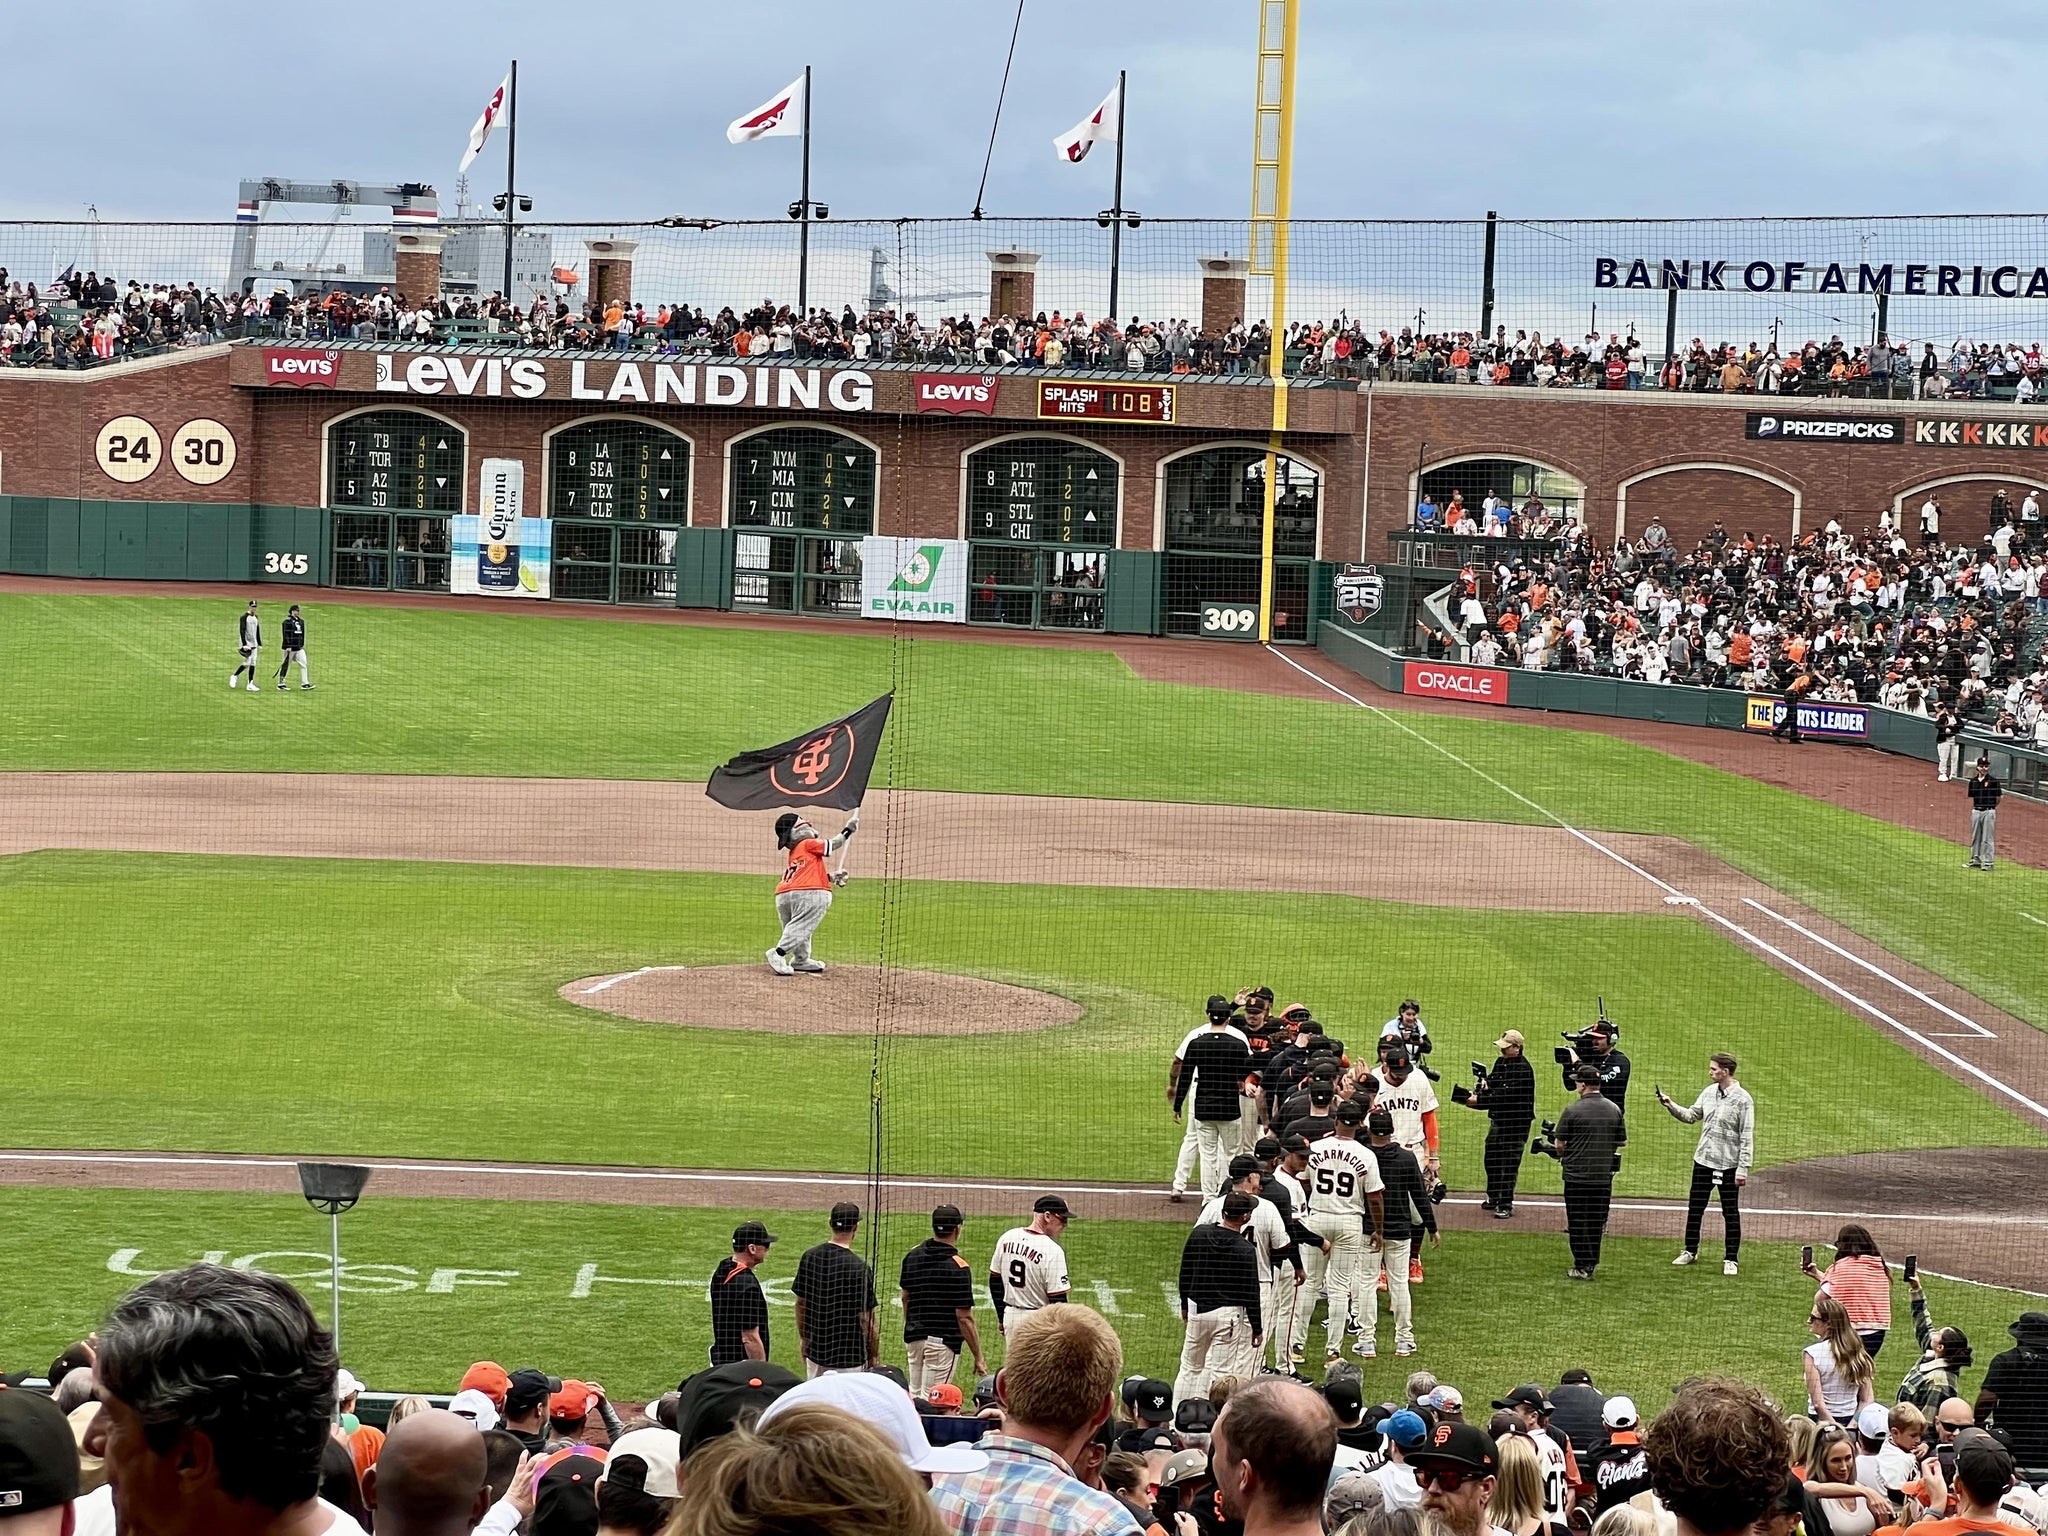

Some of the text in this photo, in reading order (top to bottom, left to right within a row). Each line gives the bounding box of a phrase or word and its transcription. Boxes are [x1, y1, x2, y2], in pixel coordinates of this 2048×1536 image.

[1595, 258, 1727, 290] BANK
[1744, 261, 1805, 292] OF
[571, 360, 874, 412] LANDING
[1045, 388, 1098, 402] SPLASH
[1112, 393, 1151, 412] 108
[1059, 402, 1086, 413] HITS
[1782, 420, 1895, 439] PRIZEPICKS
[109, 436, 151, 463] 24
[349, 441, 356, 455] 7
[374, 433, 425, 450] TB 4
[185, 438, 224, 465] 30
[369, 451, 425, 468] TOR 8
[569, 451, 576, 466] 8
[595, 443, 648, 460] LA 5
[772, 451, 832, 468] NYM 0
[590, 462, 647, 479] SEA 0
[751, 460, 758, 474] 7
[1011, 462, 1072, 479] PIT 1
[372, 473, 424, 490] AZ 2
[772, 470, 832, 488] MIA 4
[987, 470, 995, 486] 8
[348, 480, 355, 495] 5
[589, 483, 647, 500] TEX 5
[1010, 481, 1071, 499] ATL 2
[372, 492, 424, 508] SD 9
[489, 473, 507, 540] Corona
[568, 491, 576, 506] 7
[771, 492, 830, 509] CIN 2
[590, 502, 646, 520] CLE 3
[749, 500, 757, 515] 7
[1009, 504, 1071, 521] STL 0
[770, 511, 829, 529] MIL 4
[986, 512, 993, 527] 9
[1010, 523, 1071, 541] CHI 2
[264, 552, 309, 574] 365
[872, 598, 955, 614] EVA AIR
[1339, 586, 1380, 609] 25
[1204, 607, 1256, 632] 309
[1417, 671, 1492, 695] ORACLE
[1751, 704, 1771, 721] THE
[1820, 711, 1865, 732] LEADER
[1308, 1149, 1368, 1178] ENCARNACION
[1316, 1168, 1355, 1197] 59
[1003, 1242, 1043, 1264] WILLIAMS
[1009, 1259, 1026, 1288] 9
[1596, 1450, 1648, 1490] Giants
